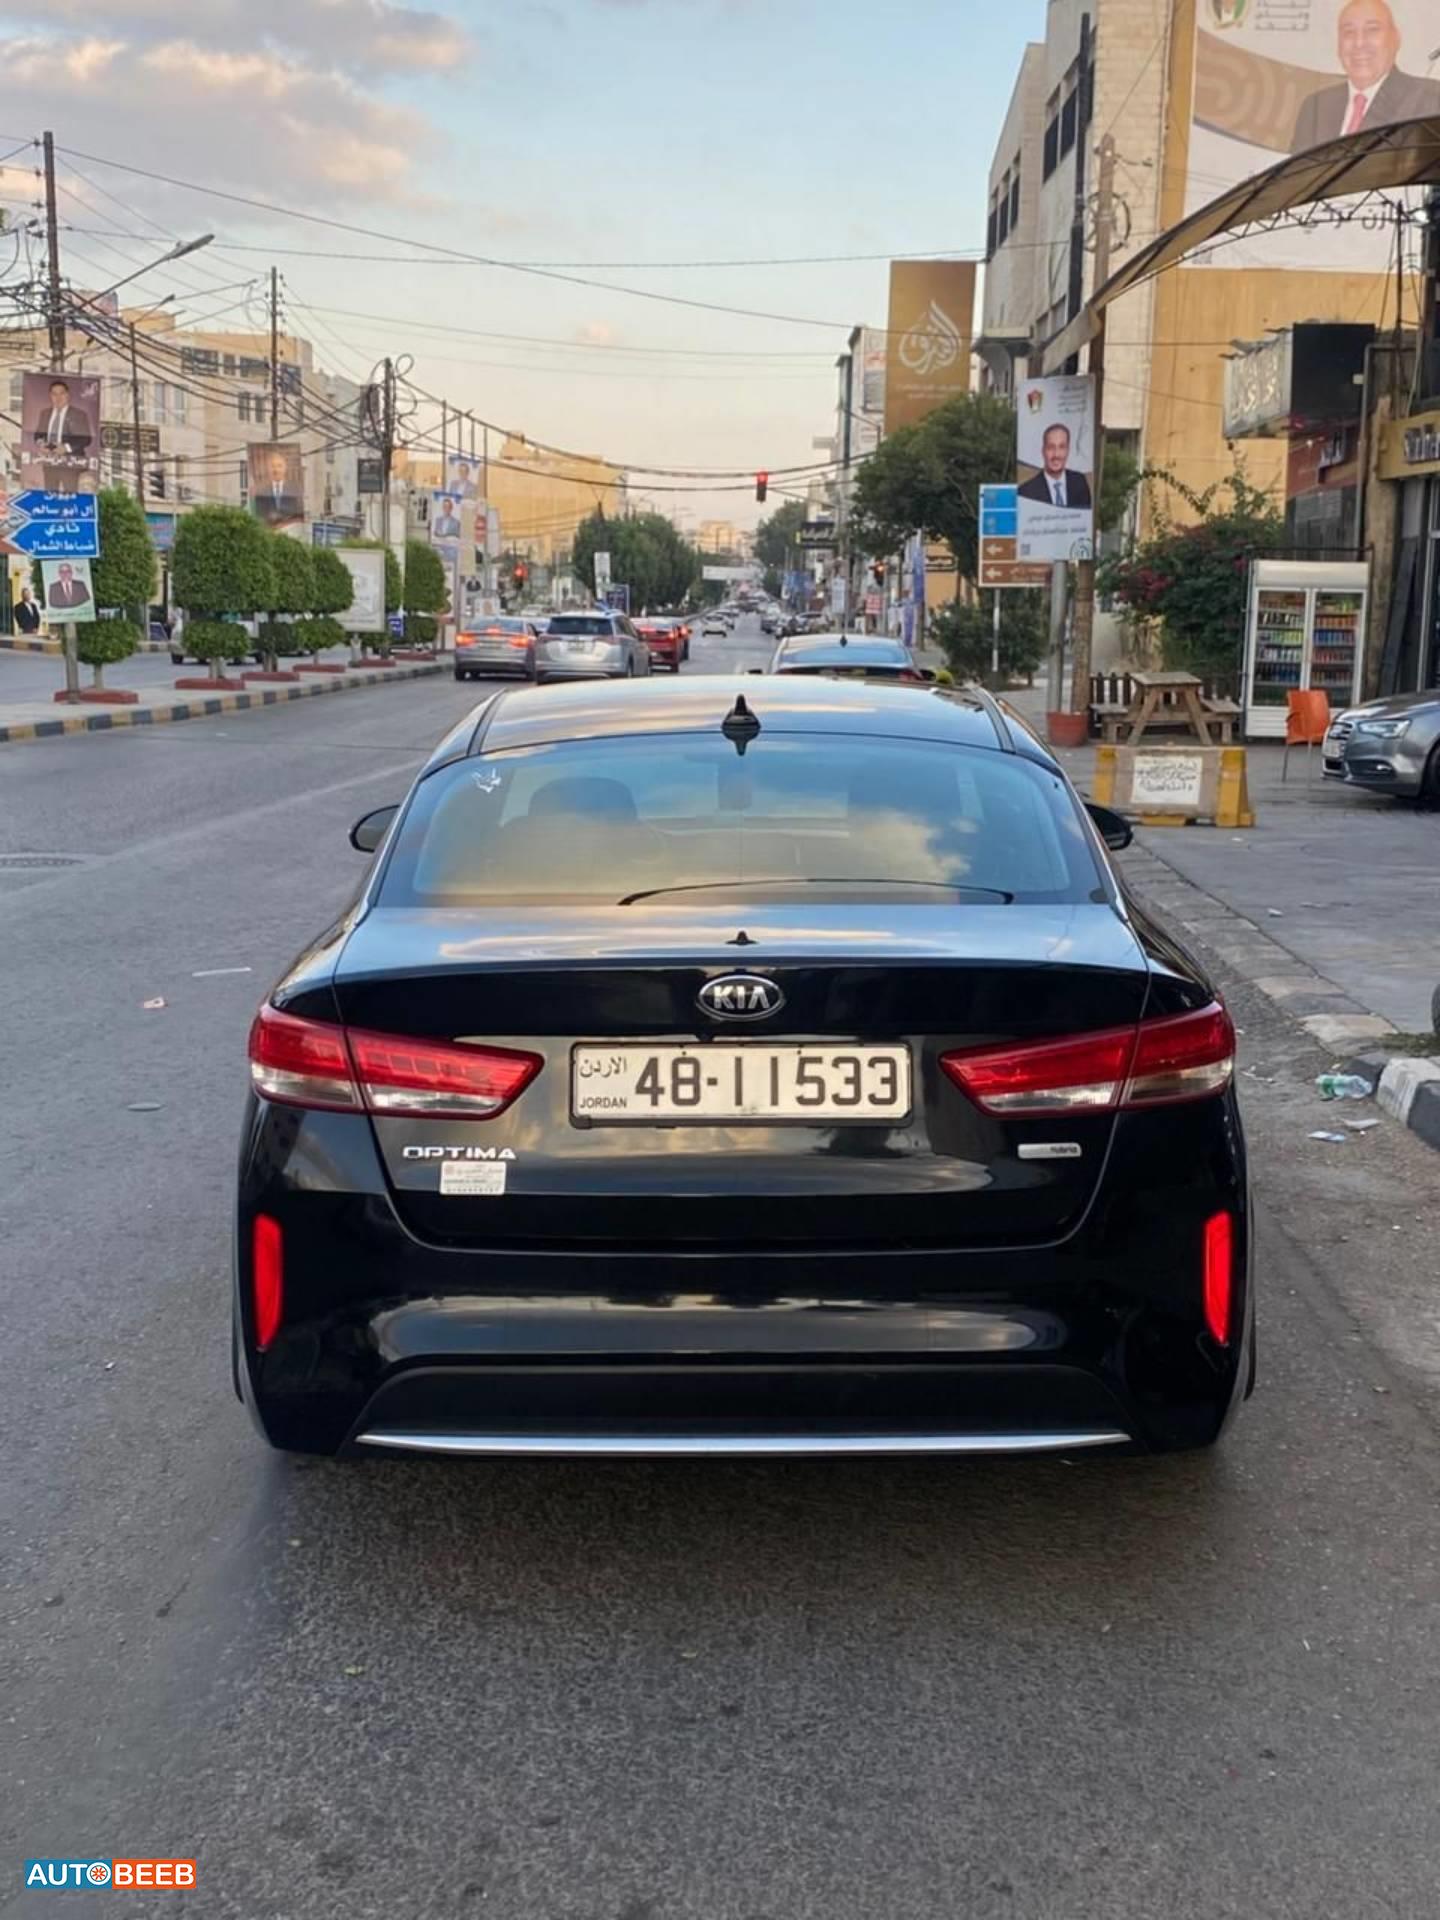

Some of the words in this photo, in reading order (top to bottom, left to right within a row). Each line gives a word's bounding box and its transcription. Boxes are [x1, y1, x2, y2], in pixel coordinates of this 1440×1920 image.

[32, 504, 59, 516] سالم
[44, 521, 80, 537] نادي
[28, 539, 61, 553] الشمال
[63, 540, 95, 551] ضباط
[713, 985, 770, 1009] KIA
[635, 1056, 898, 1107] 48-11533
[579, 1097, 627, 1109] JORDAN
[402, 1146, 517, 1159] OPTIMA
